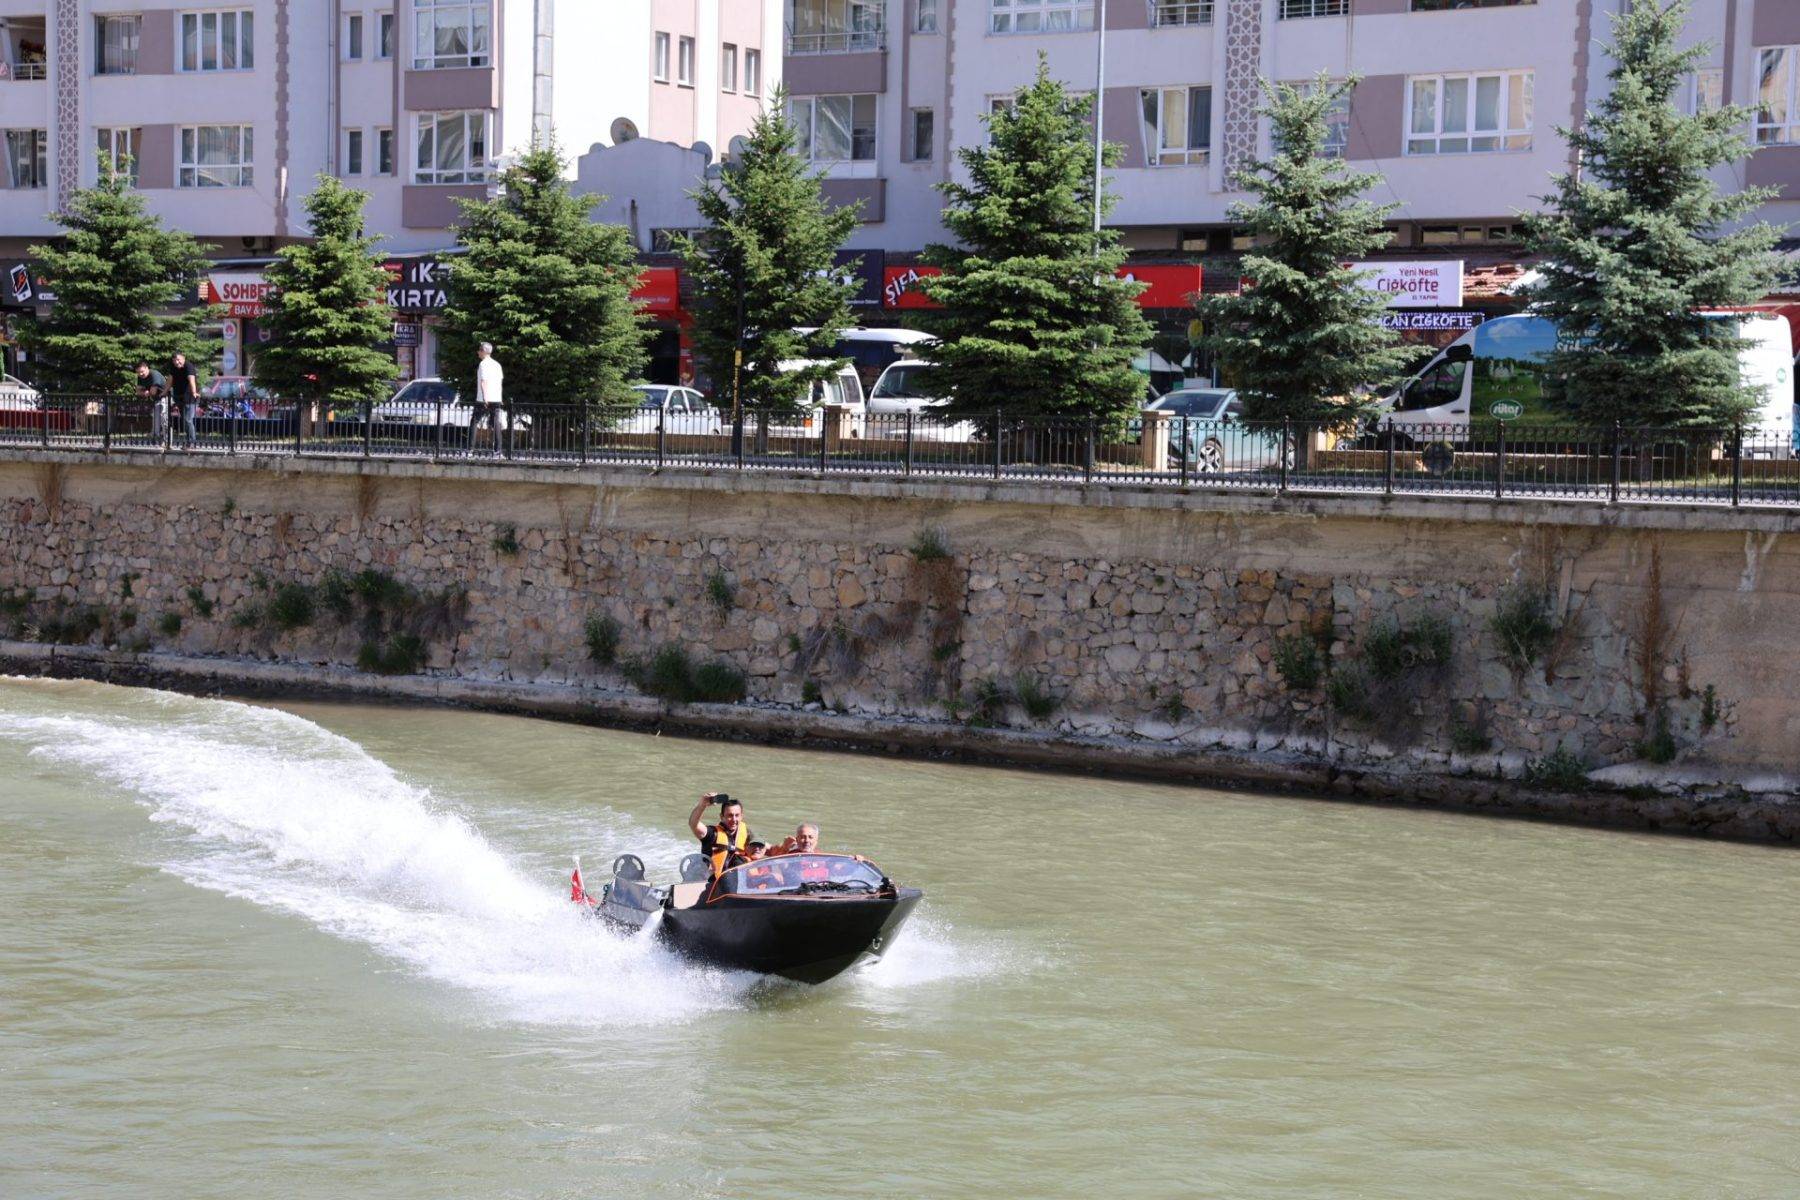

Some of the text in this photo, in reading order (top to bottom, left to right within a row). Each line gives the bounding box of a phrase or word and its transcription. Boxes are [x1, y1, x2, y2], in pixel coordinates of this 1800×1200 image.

[1400, 267, 1438, 277] Yeni Nesil
[234, 305, 251, 315] BAY
